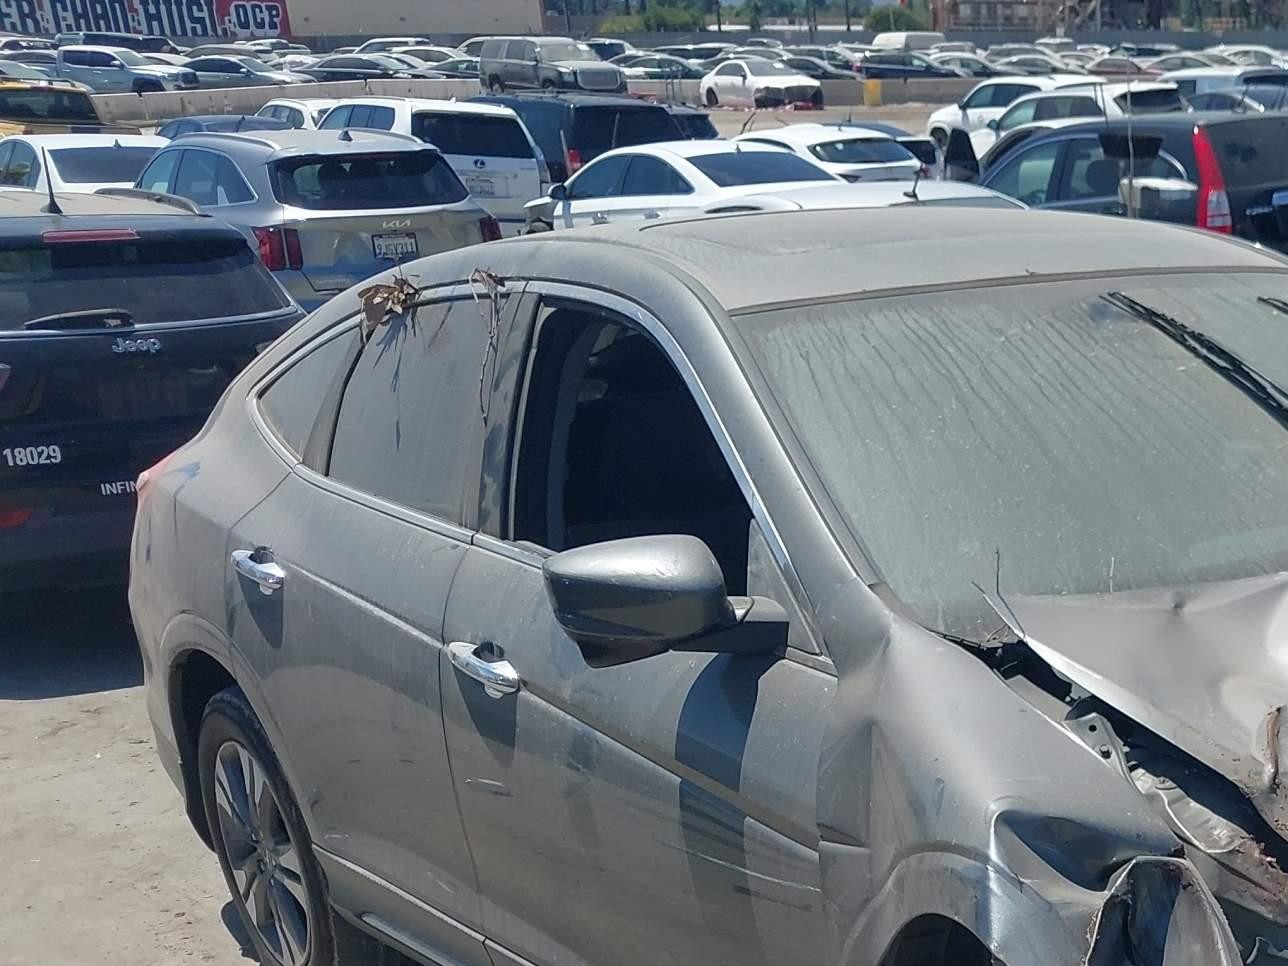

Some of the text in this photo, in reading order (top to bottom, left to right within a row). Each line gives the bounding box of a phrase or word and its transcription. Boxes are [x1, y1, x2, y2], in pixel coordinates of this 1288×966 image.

[234, 4, 280, 30] OCP
[112, 337, 161, 353] Jeep
[3, 445, 61, 466] 18029
